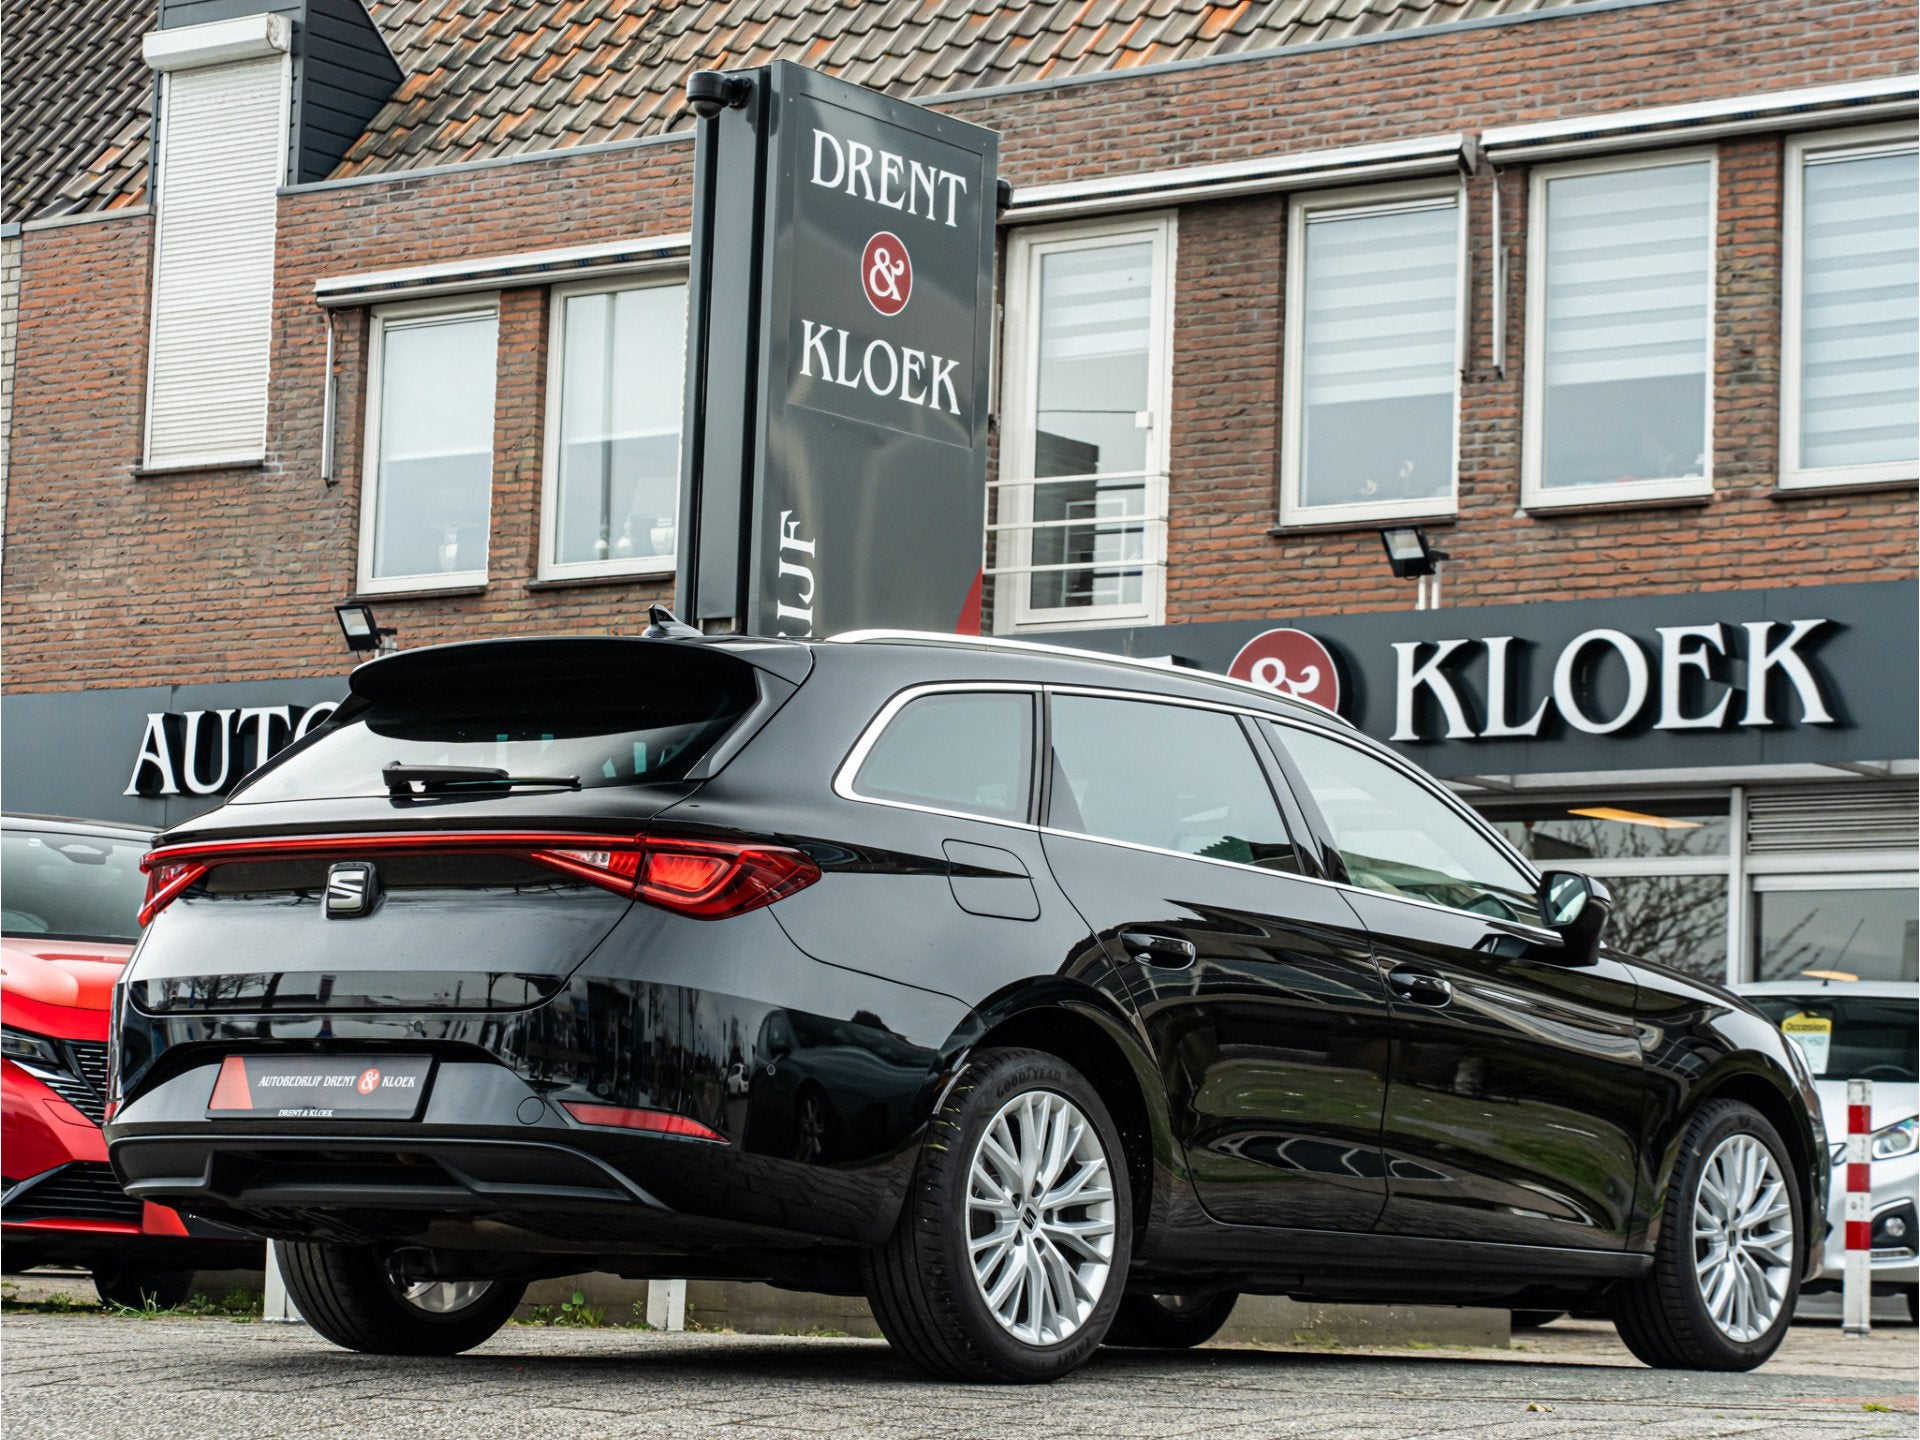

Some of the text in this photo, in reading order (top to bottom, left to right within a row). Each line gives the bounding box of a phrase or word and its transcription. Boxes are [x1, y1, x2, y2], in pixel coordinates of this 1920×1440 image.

[811, 128, 968, 228] DRENT
[869, 247, 905, 301] &
[799, 319, 962, 416] KLOEK
[777, 510, 816, 637] IJF
[1389, 618, 1835, 742] KLOEK
[1786, 1022, 1827, 1031] Occasion
[258, 1070, 417, 1090] AUTOBEDRIJF DRENT & KLOEK
[278, 1109, 302, 1117] DRENT
[308, 1109, 334, 1117] KLOEK
